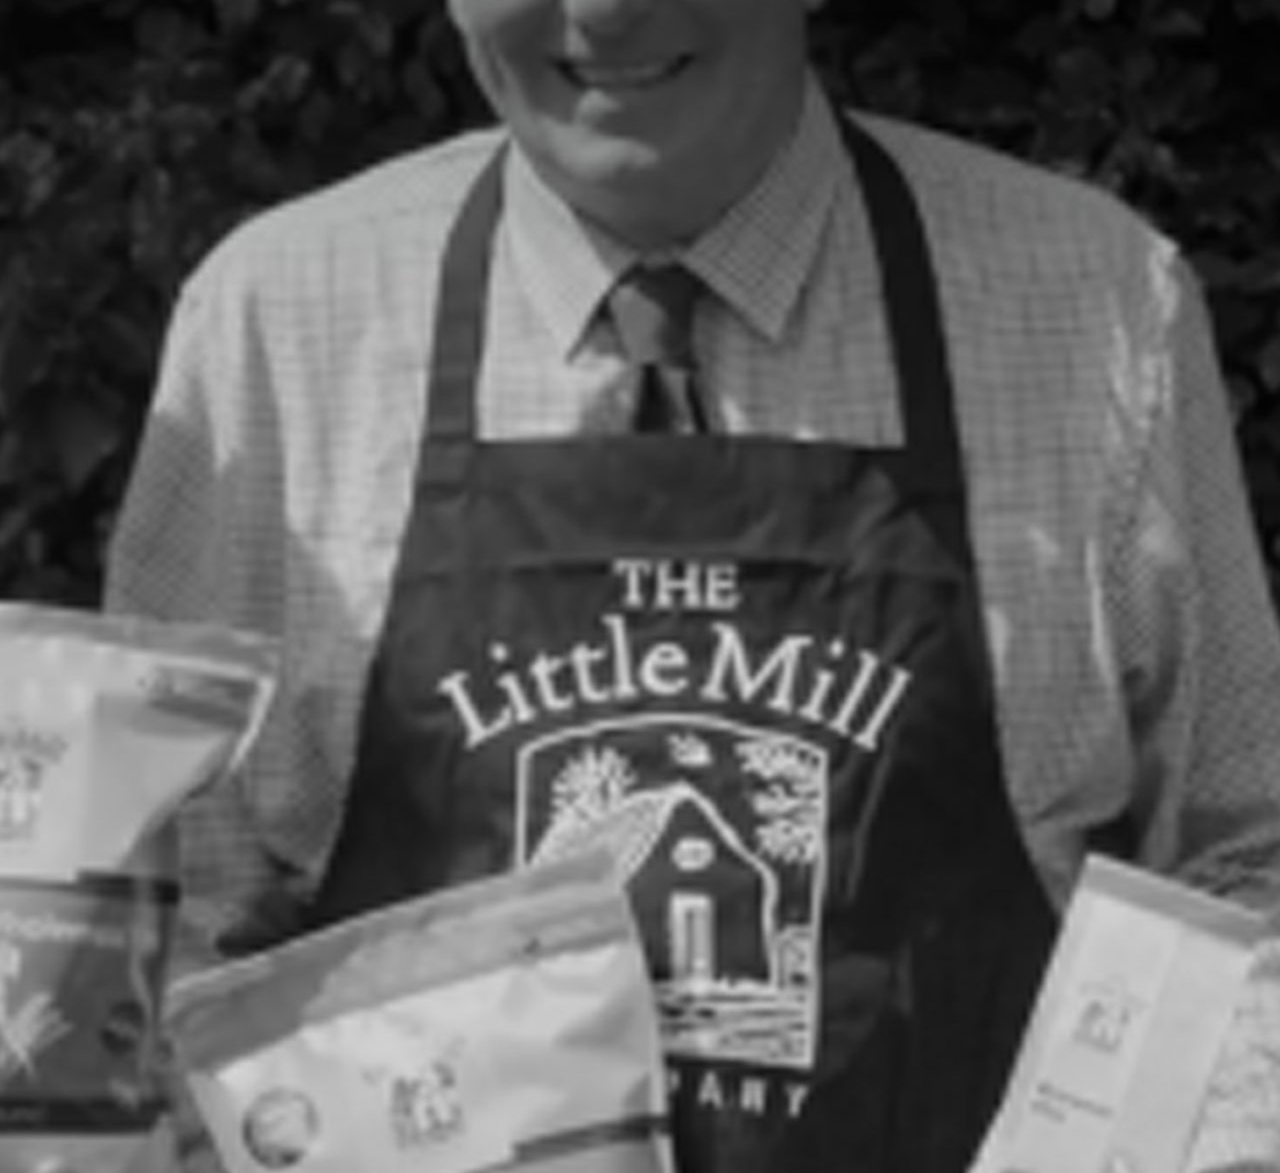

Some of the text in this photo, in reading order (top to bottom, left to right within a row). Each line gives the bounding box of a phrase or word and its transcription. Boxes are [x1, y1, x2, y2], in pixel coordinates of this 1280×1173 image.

[612, 558, 741, 610] THE
[437, 614, 912, 750] Little Mill
